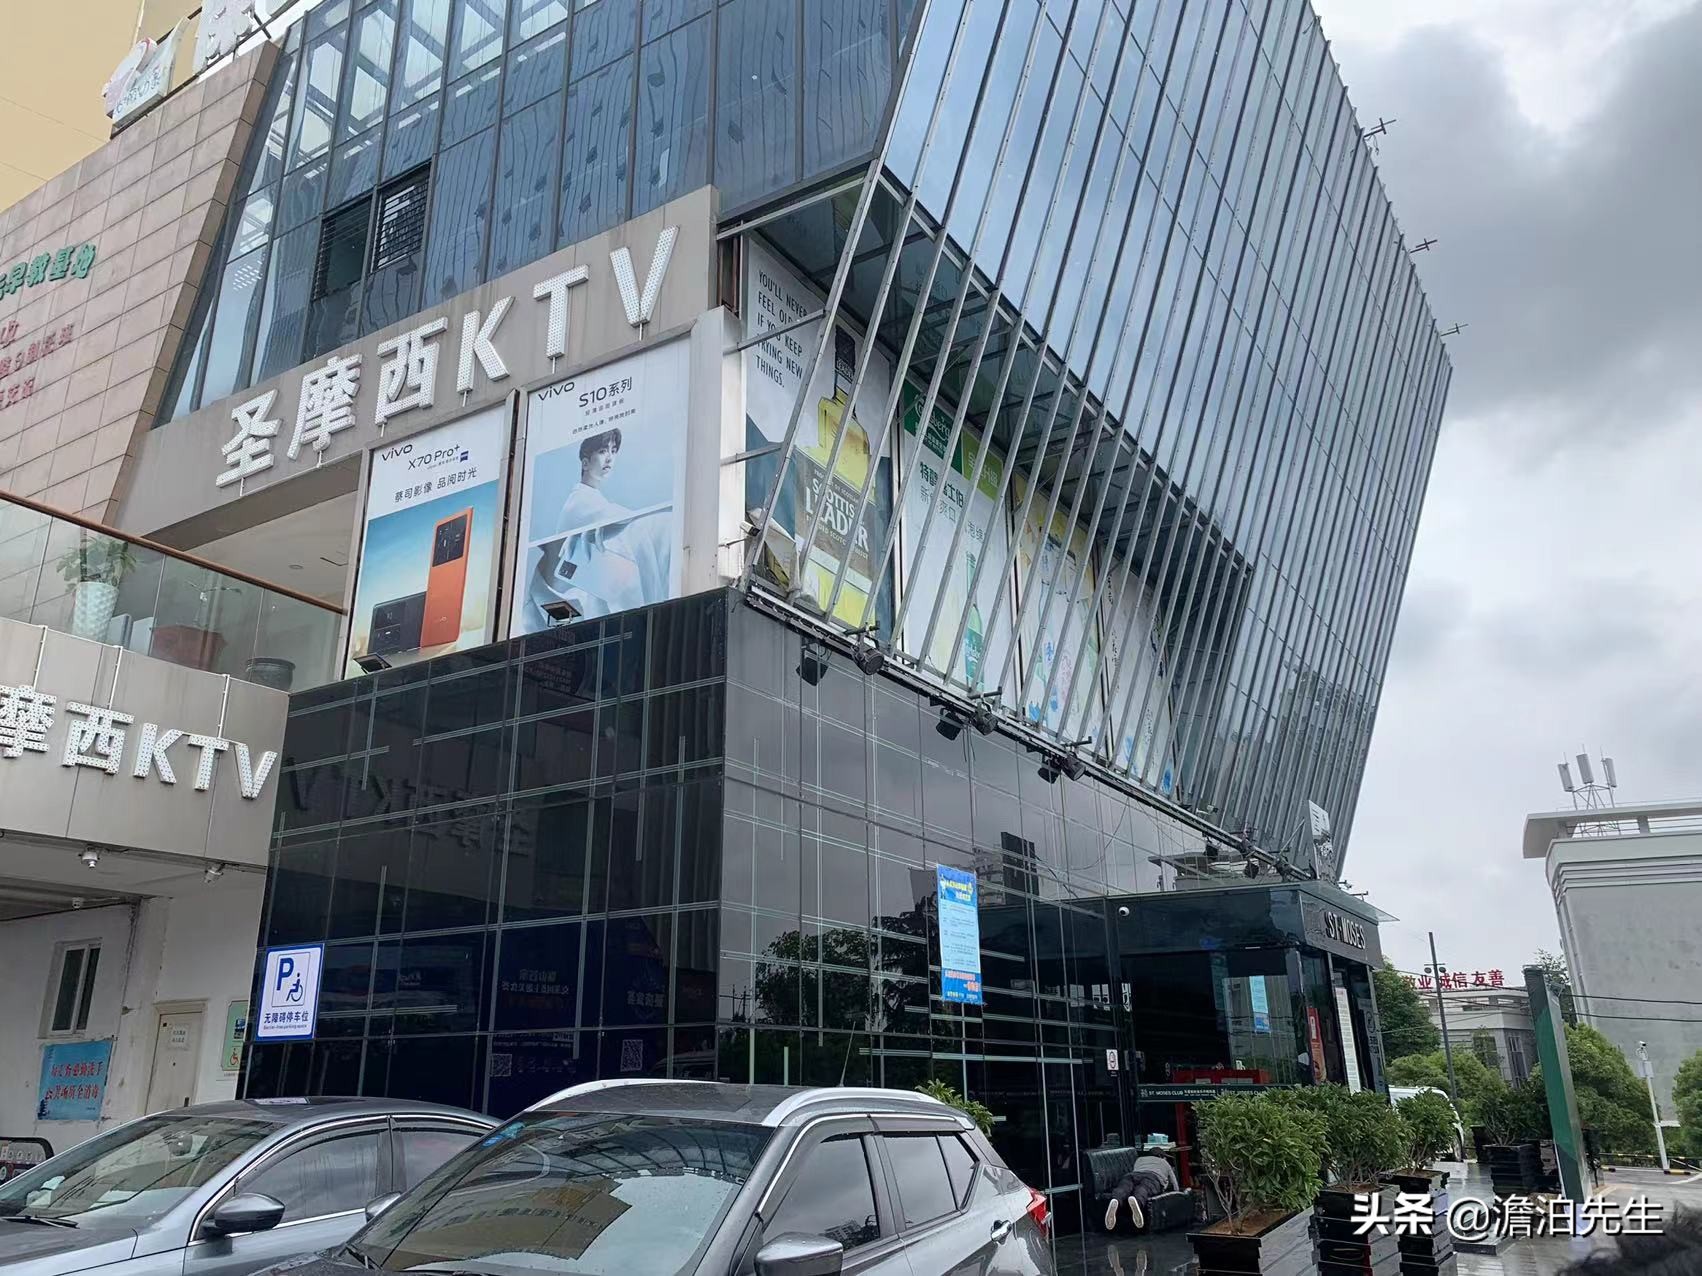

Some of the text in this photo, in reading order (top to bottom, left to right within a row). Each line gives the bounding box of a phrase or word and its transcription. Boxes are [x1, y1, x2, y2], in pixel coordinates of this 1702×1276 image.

[758, 269, 783, 302] YOU'LL
[757, 291, 776, 317] FEEL
[757, 312, 764, 328] IF
[784, 333, 803, 357] KEEP
[756, 355, 785, 388] THINGS.
[786, 357, 803, 380] NEW
[538, 381, 575, 401] vivo
[579, 376, 633, 408] S10系列
[381, 444, 413, 461] vivo
[407, 454, 433, 470] X70
[434, 444, 460, 462] Pro+
[394, 481, 433, 503] 蔡司影像
[276, 956, 295, 991] P
[1471, 968, 1505, 988] 友善
[263, 1010, 309, 1024] 无障碍停车位
